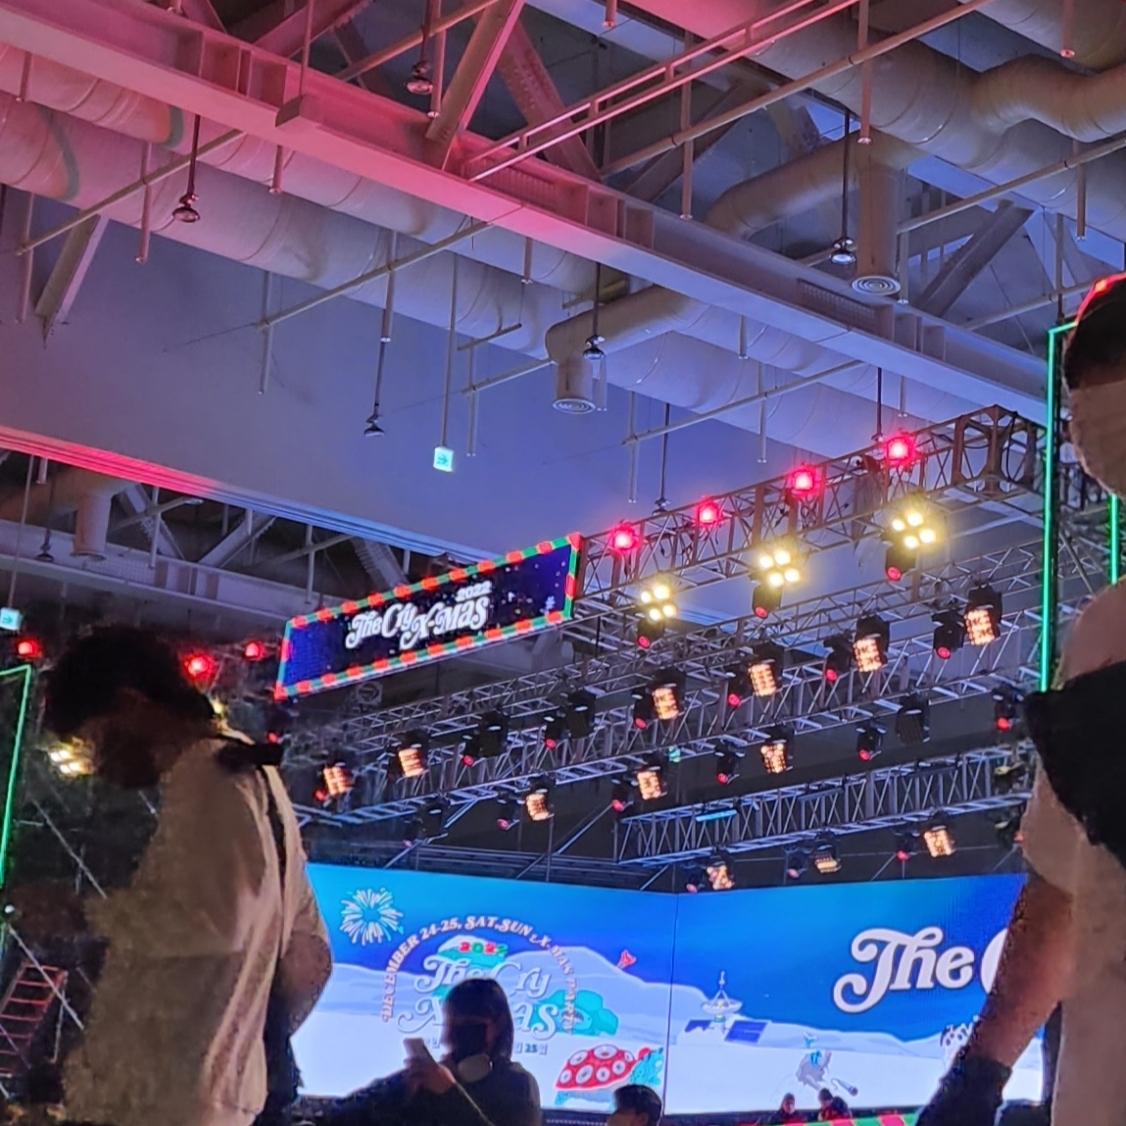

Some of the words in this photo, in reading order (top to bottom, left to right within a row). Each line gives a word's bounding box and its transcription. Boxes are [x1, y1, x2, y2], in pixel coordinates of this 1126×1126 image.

[455, 580, 493, 602] 2022
[345, 610, 383, 649] The
[381, 602, 418, 638] Cry
[400, 596, 490, 650] X-Mas
[459, 941, 509, 958] 2022
[832, 926, 975, 1014] The
[382, 933, 421, 1023] DECEMBER
